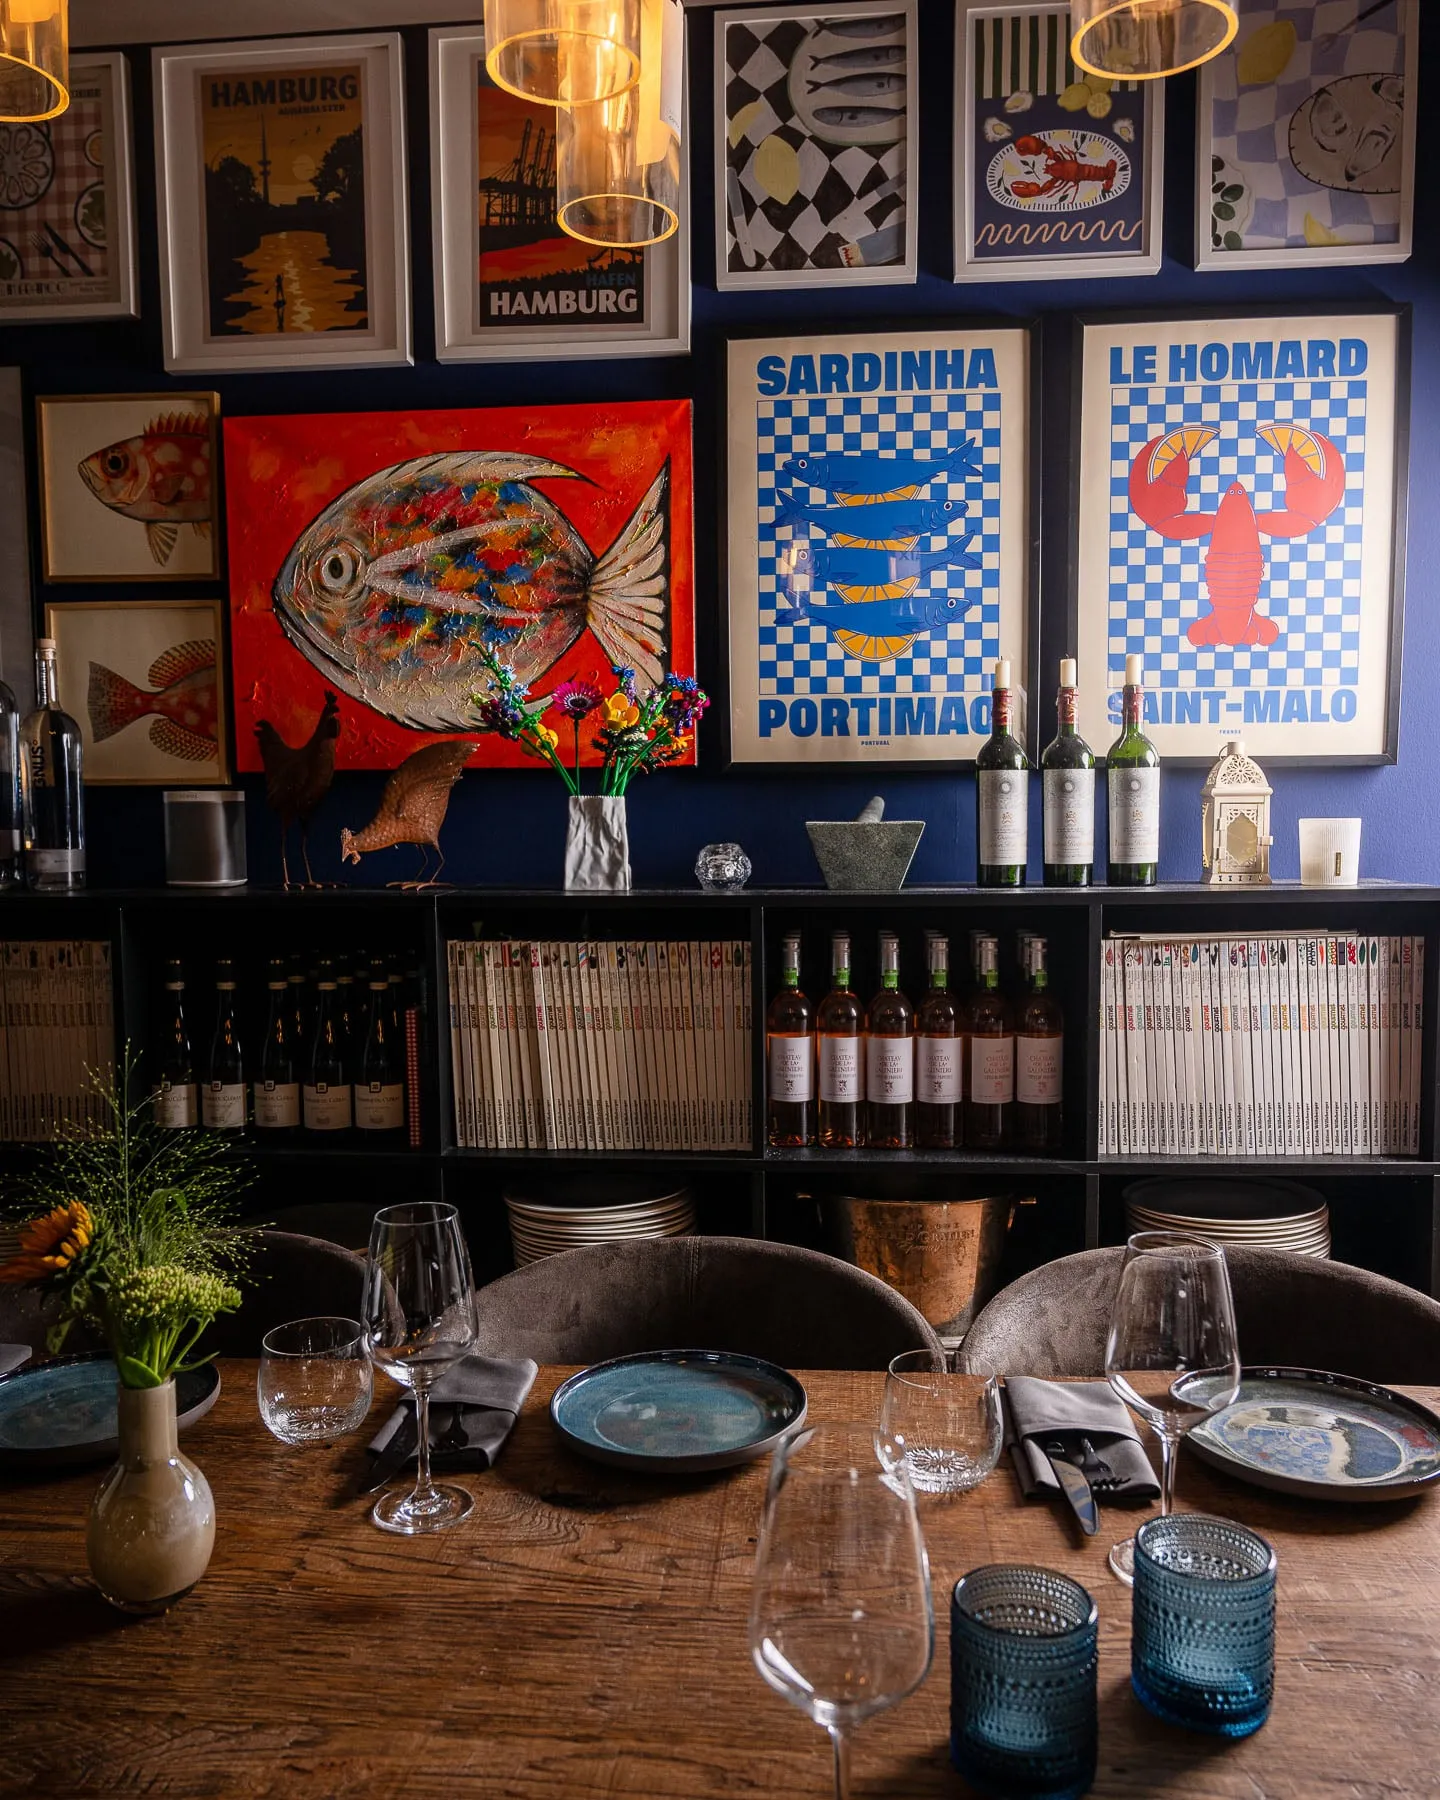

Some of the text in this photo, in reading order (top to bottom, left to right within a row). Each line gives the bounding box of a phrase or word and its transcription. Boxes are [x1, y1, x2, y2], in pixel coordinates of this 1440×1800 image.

[211, 74, 358, 108] HAMBURG
[586, 272, 636, 286] HAFEN
[490, 288, 638, 316] HAMBURG
[756, 348, 998, 396] SARDINHA
[1109, 338, 1368, 385] LE HOMARD
[758, 696, 992, 738] PORTIMAO
[1107, 689, 1357, 725] SAINT-MALO
